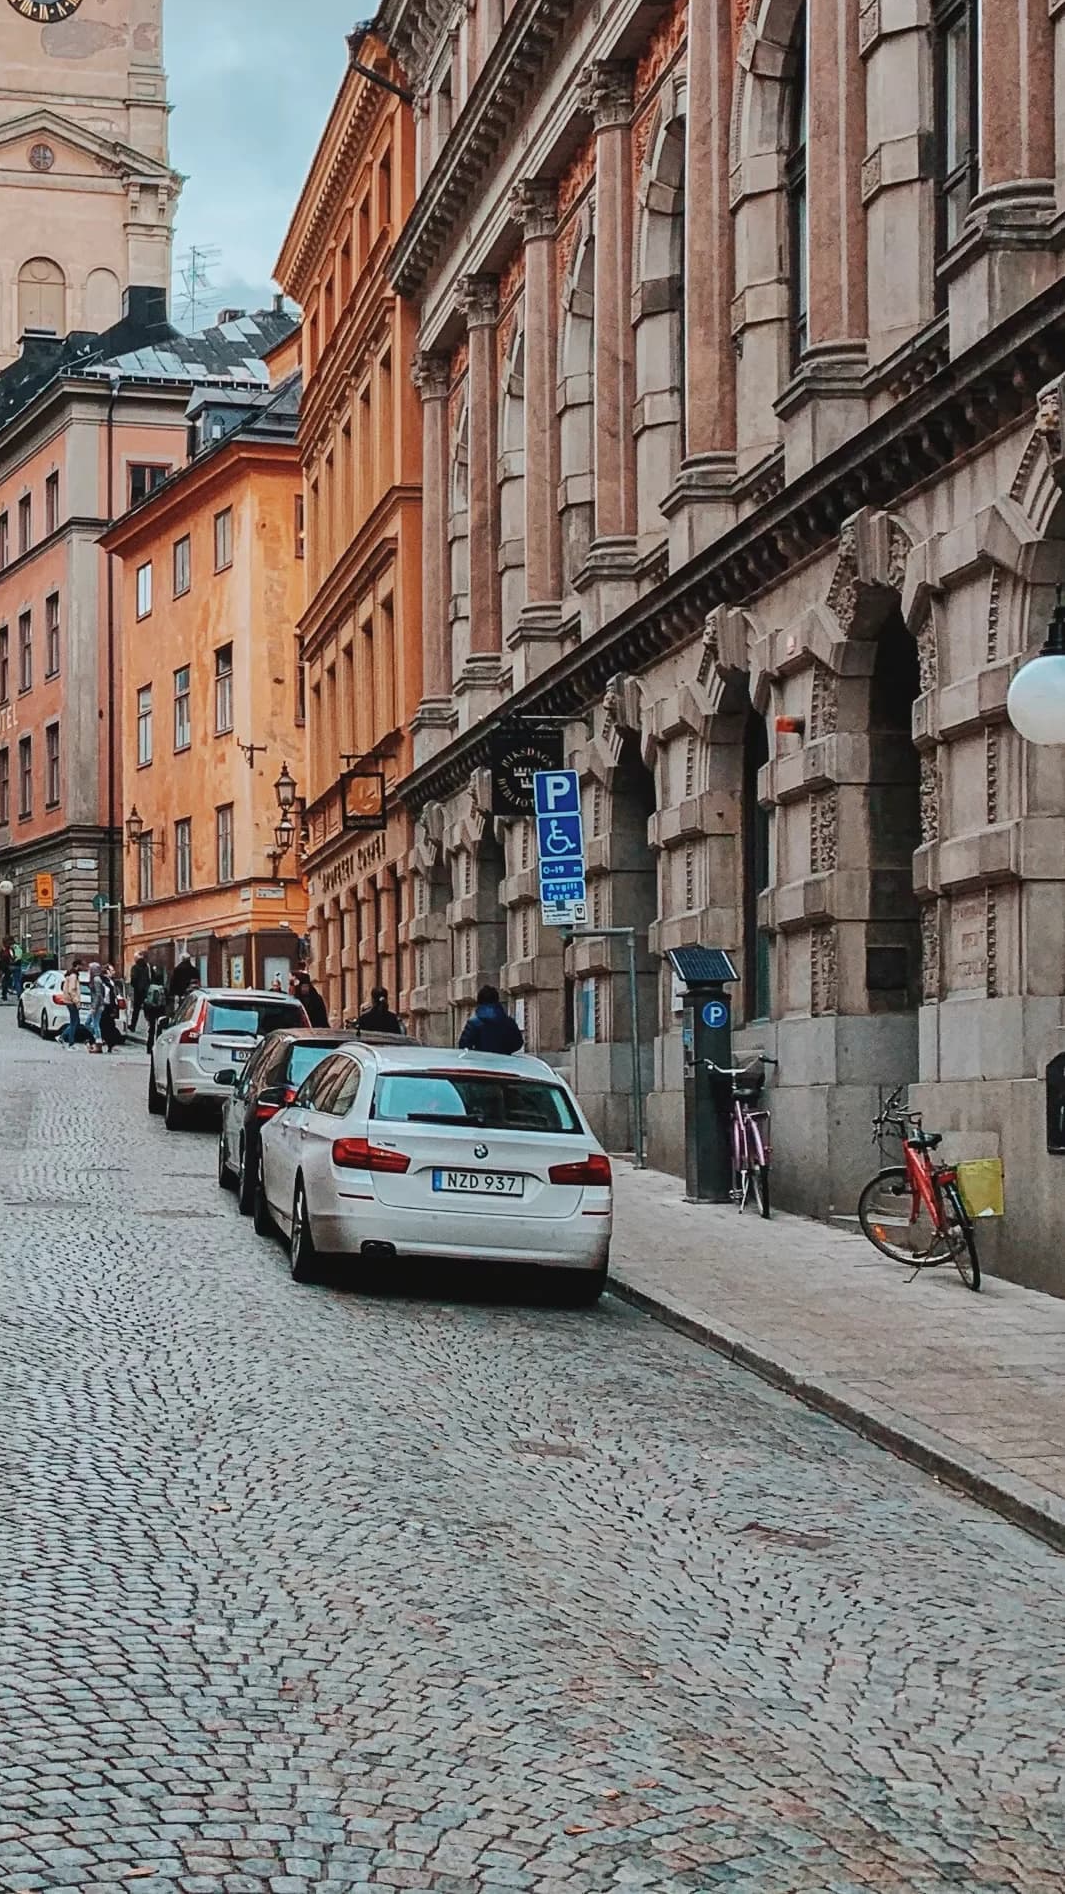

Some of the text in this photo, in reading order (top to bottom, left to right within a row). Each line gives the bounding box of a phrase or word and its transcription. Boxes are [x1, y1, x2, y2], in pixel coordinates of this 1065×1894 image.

[545, 775, 570, 810] P
[574, 891, 580, 899] 2
[710, 1007, 723, 1024] P
[448, 1173, 516, 1192] NZD 937
